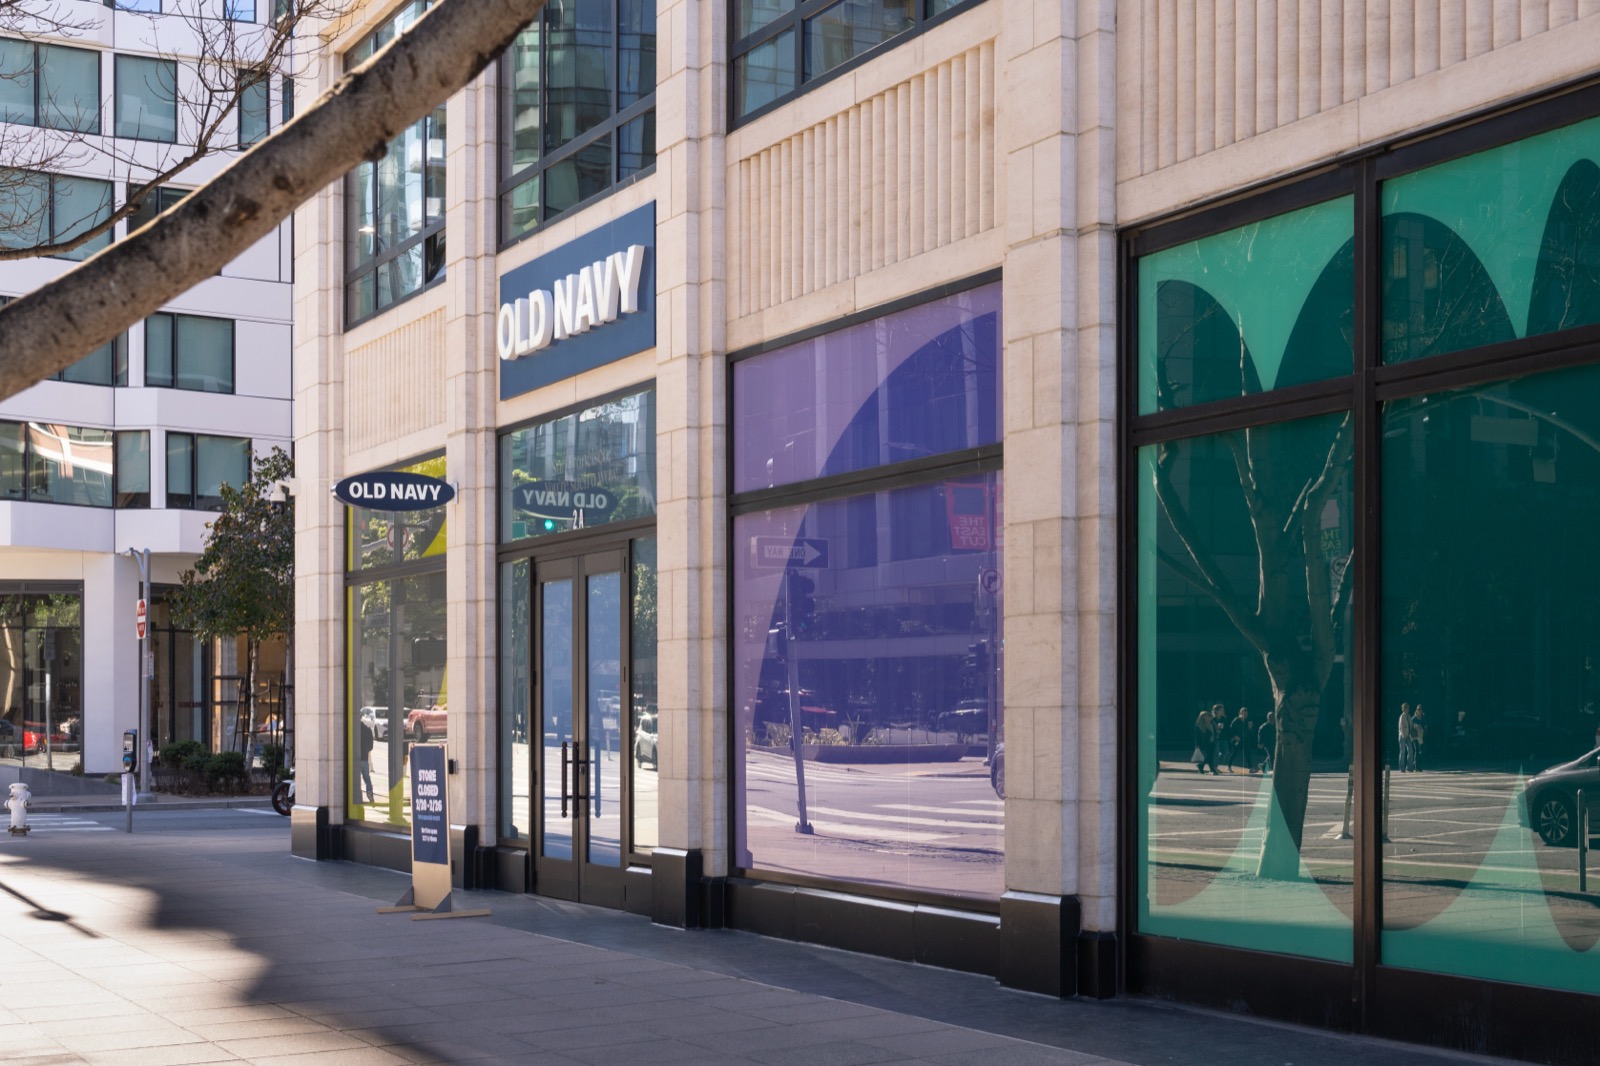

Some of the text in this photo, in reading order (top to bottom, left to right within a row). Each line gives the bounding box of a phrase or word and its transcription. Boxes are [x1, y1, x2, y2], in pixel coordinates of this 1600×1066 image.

[497, 244, 645, 361] OLD NAVY
[349, 481, 441, 501] OLD NAVY
[418, 769, 437, 781] STORE
[417, 784, 439, 797] CLOSED
